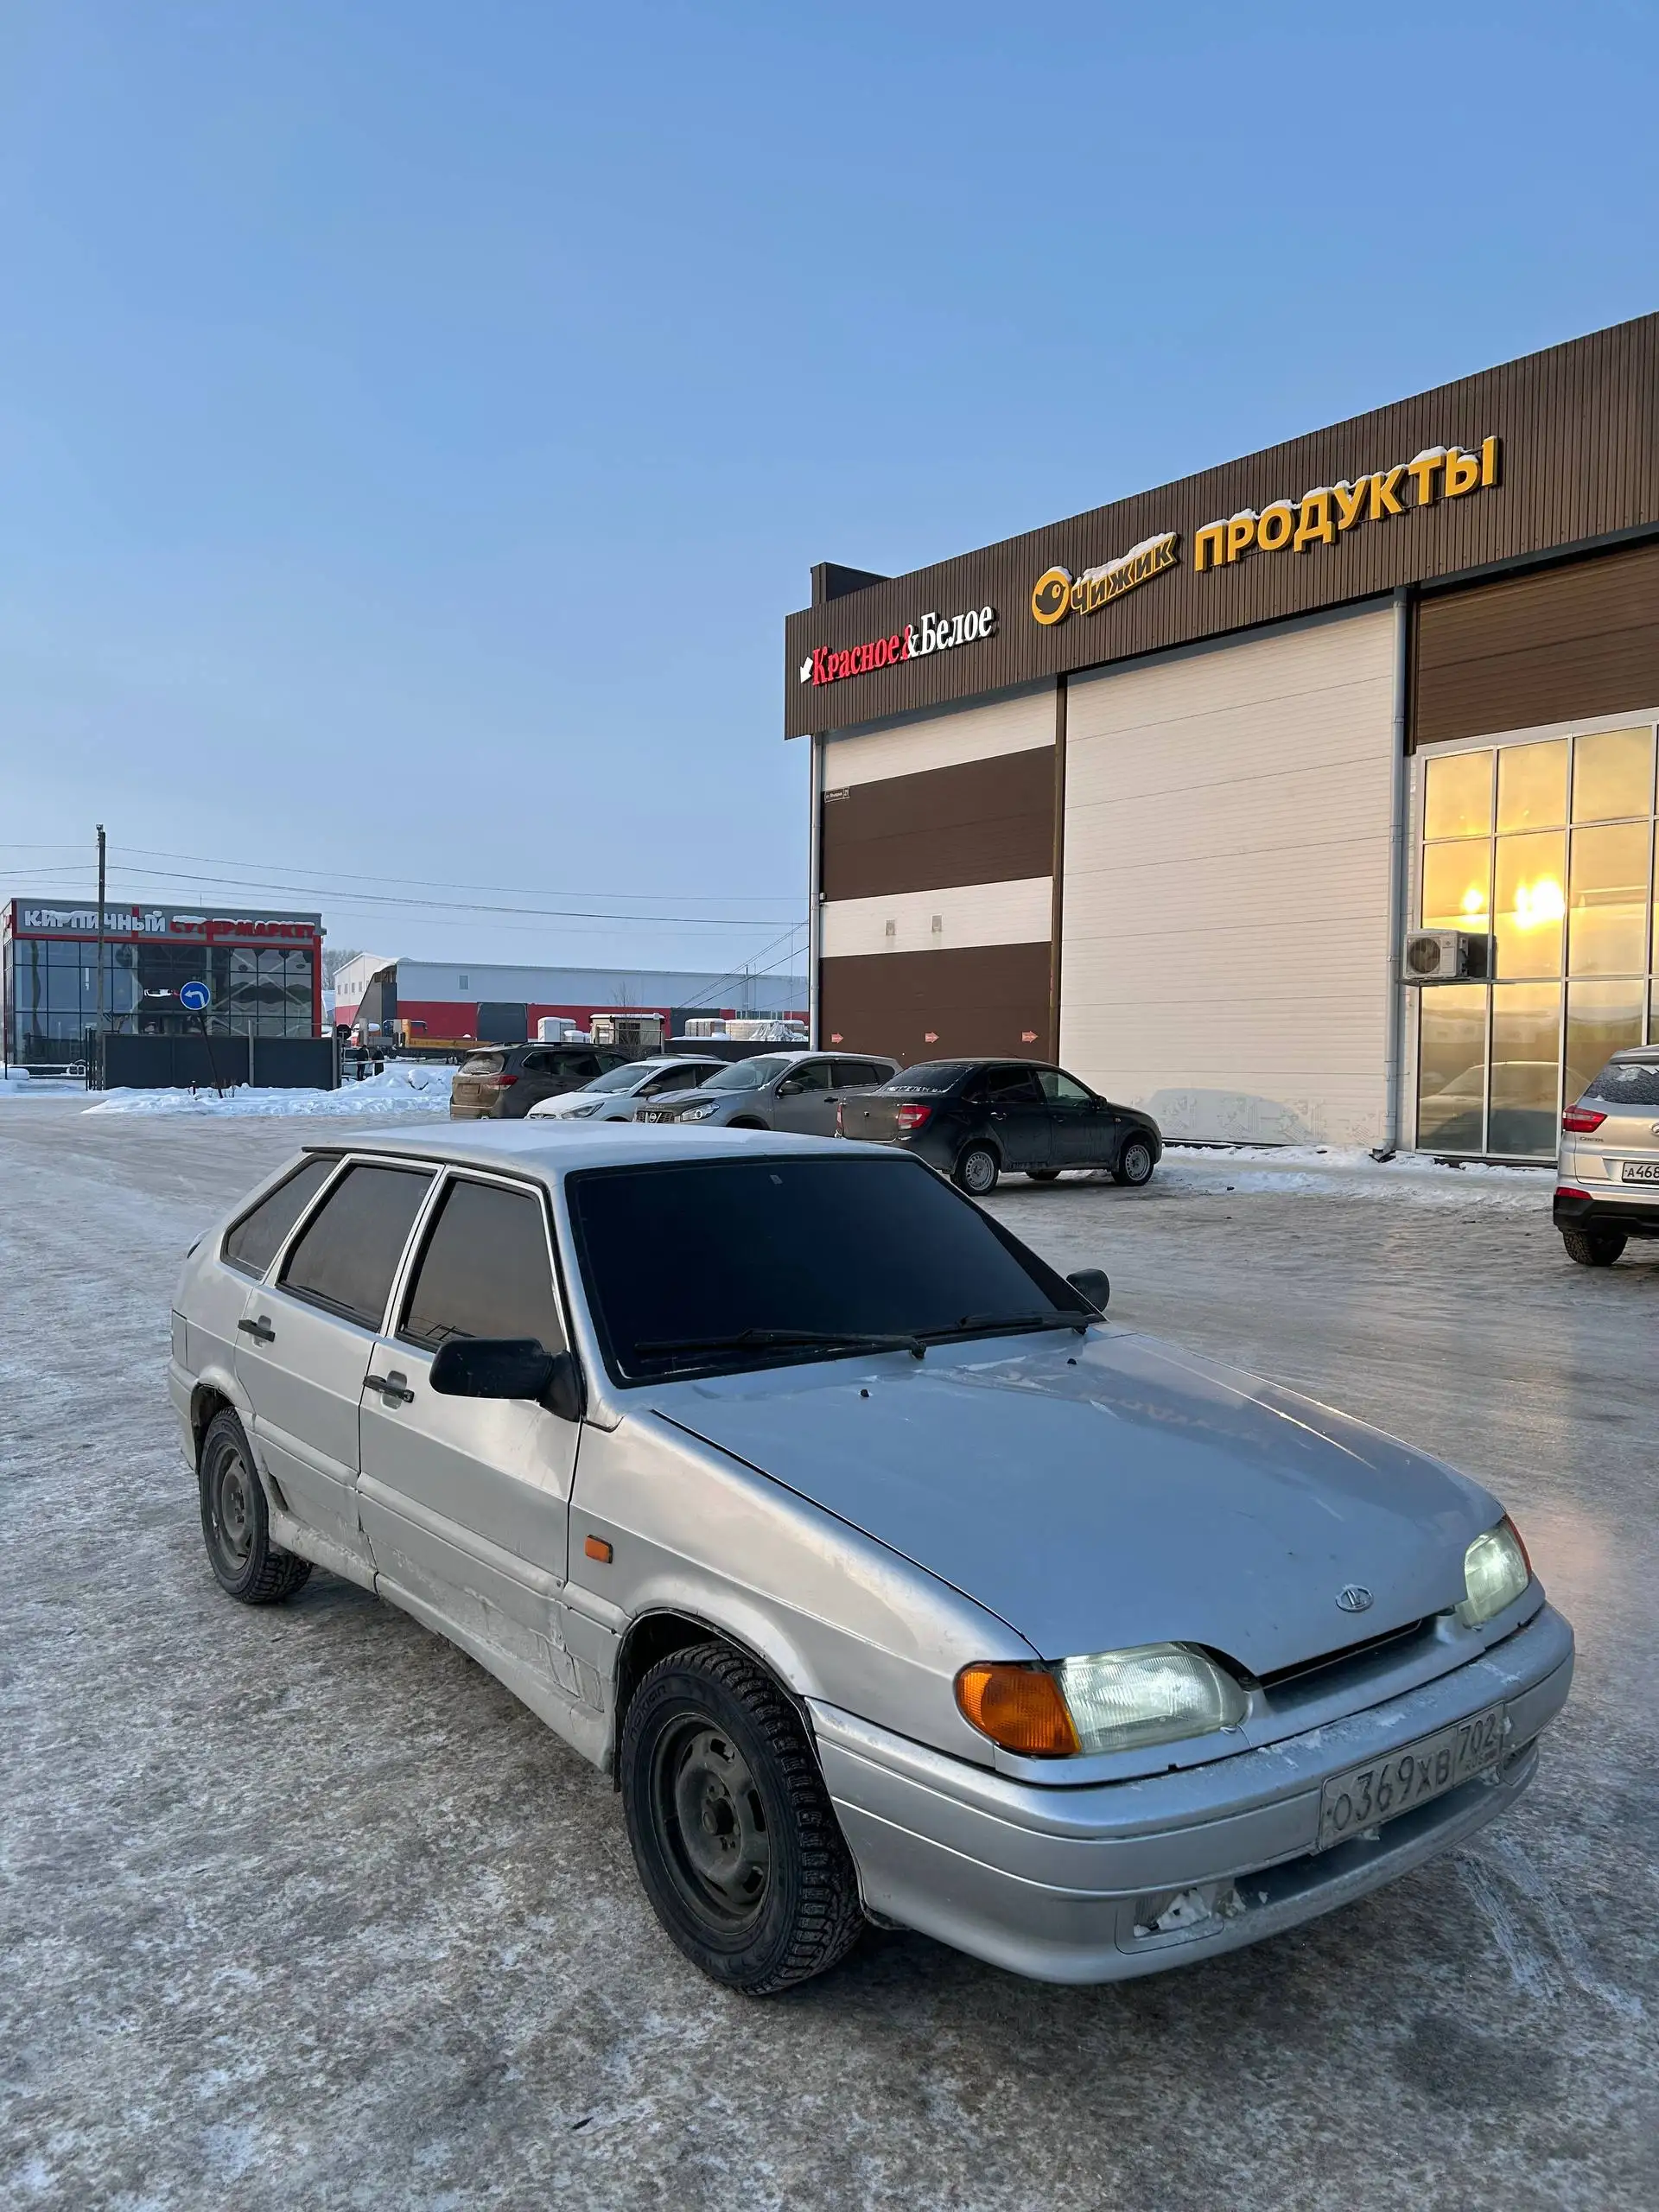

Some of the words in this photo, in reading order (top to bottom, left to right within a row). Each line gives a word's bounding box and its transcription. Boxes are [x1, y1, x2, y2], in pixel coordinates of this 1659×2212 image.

[1195, 435, 1498, 572] ПРОДУКТЫ
[170, 918, 315, 938] СУПЕРМАРКЕТ
[1459, 1713, 1496, 1761] 702
